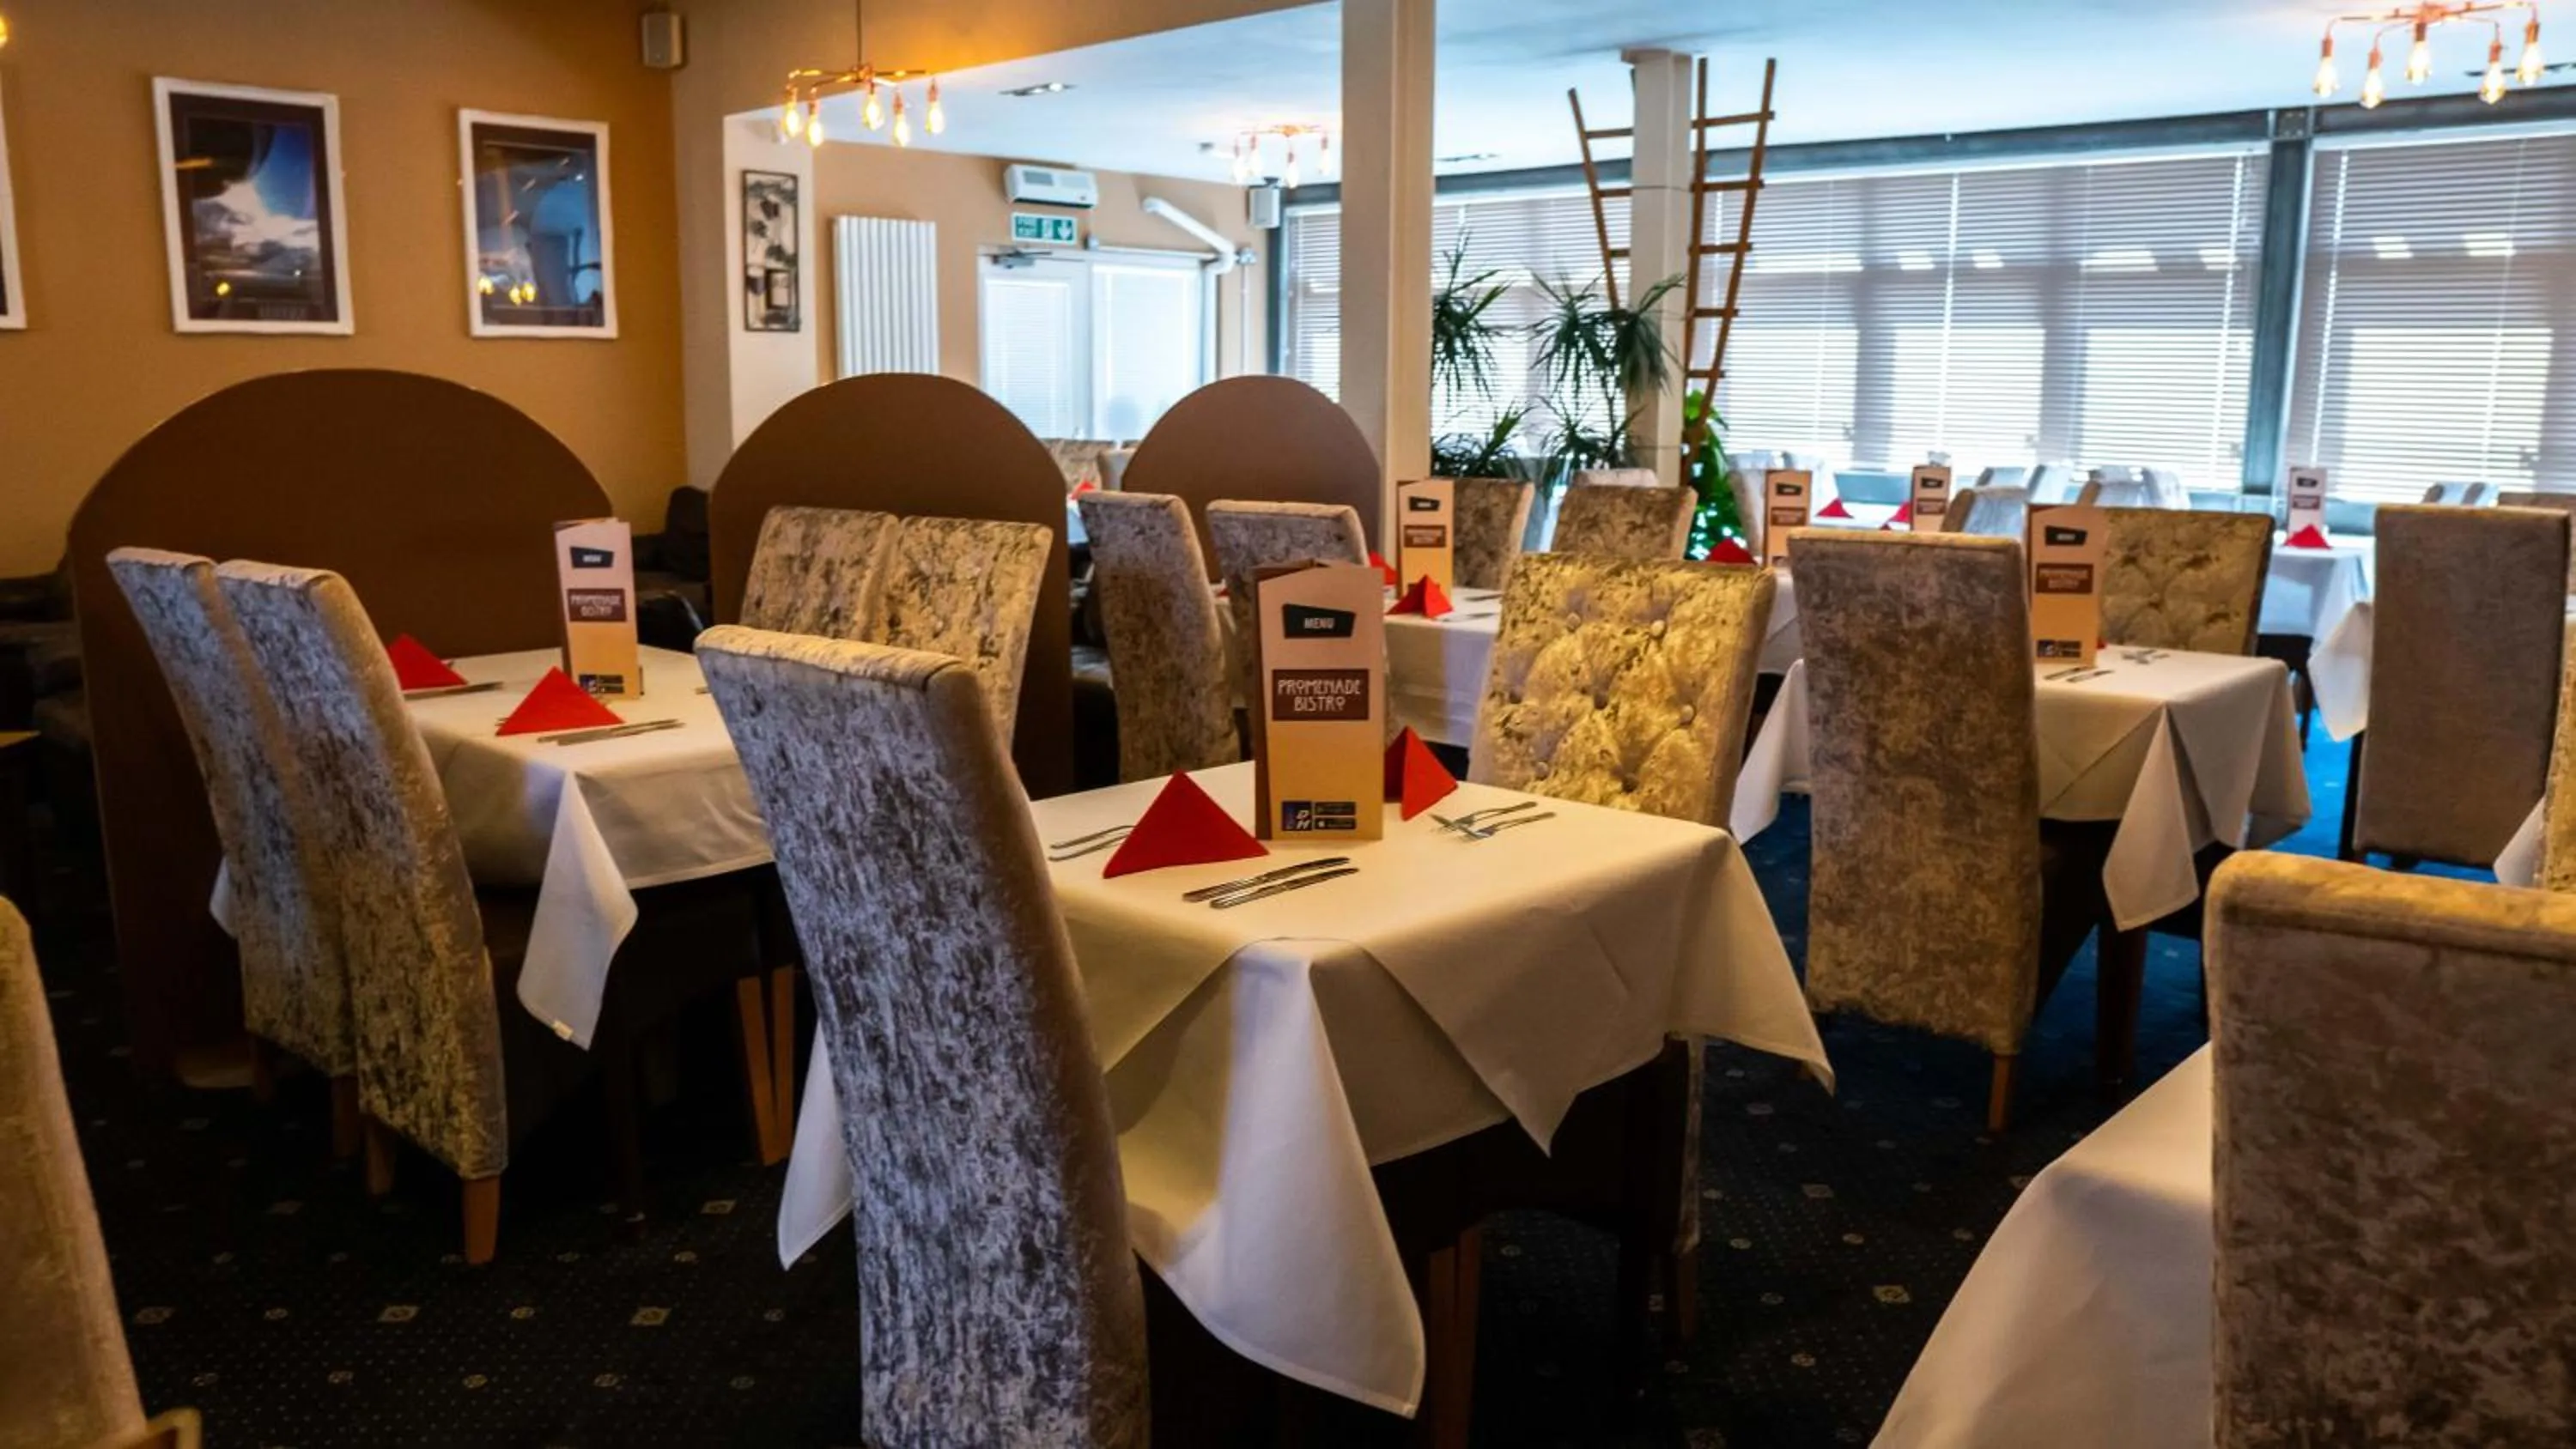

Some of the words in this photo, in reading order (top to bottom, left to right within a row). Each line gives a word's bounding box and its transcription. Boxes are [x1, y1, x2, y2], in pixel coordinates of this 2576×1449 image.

[1303, 617, 1335, 629] MENU
[1276, 679, 1361, 695] PROMENADE
[1293, 696, 1346, 712] BISTRO
